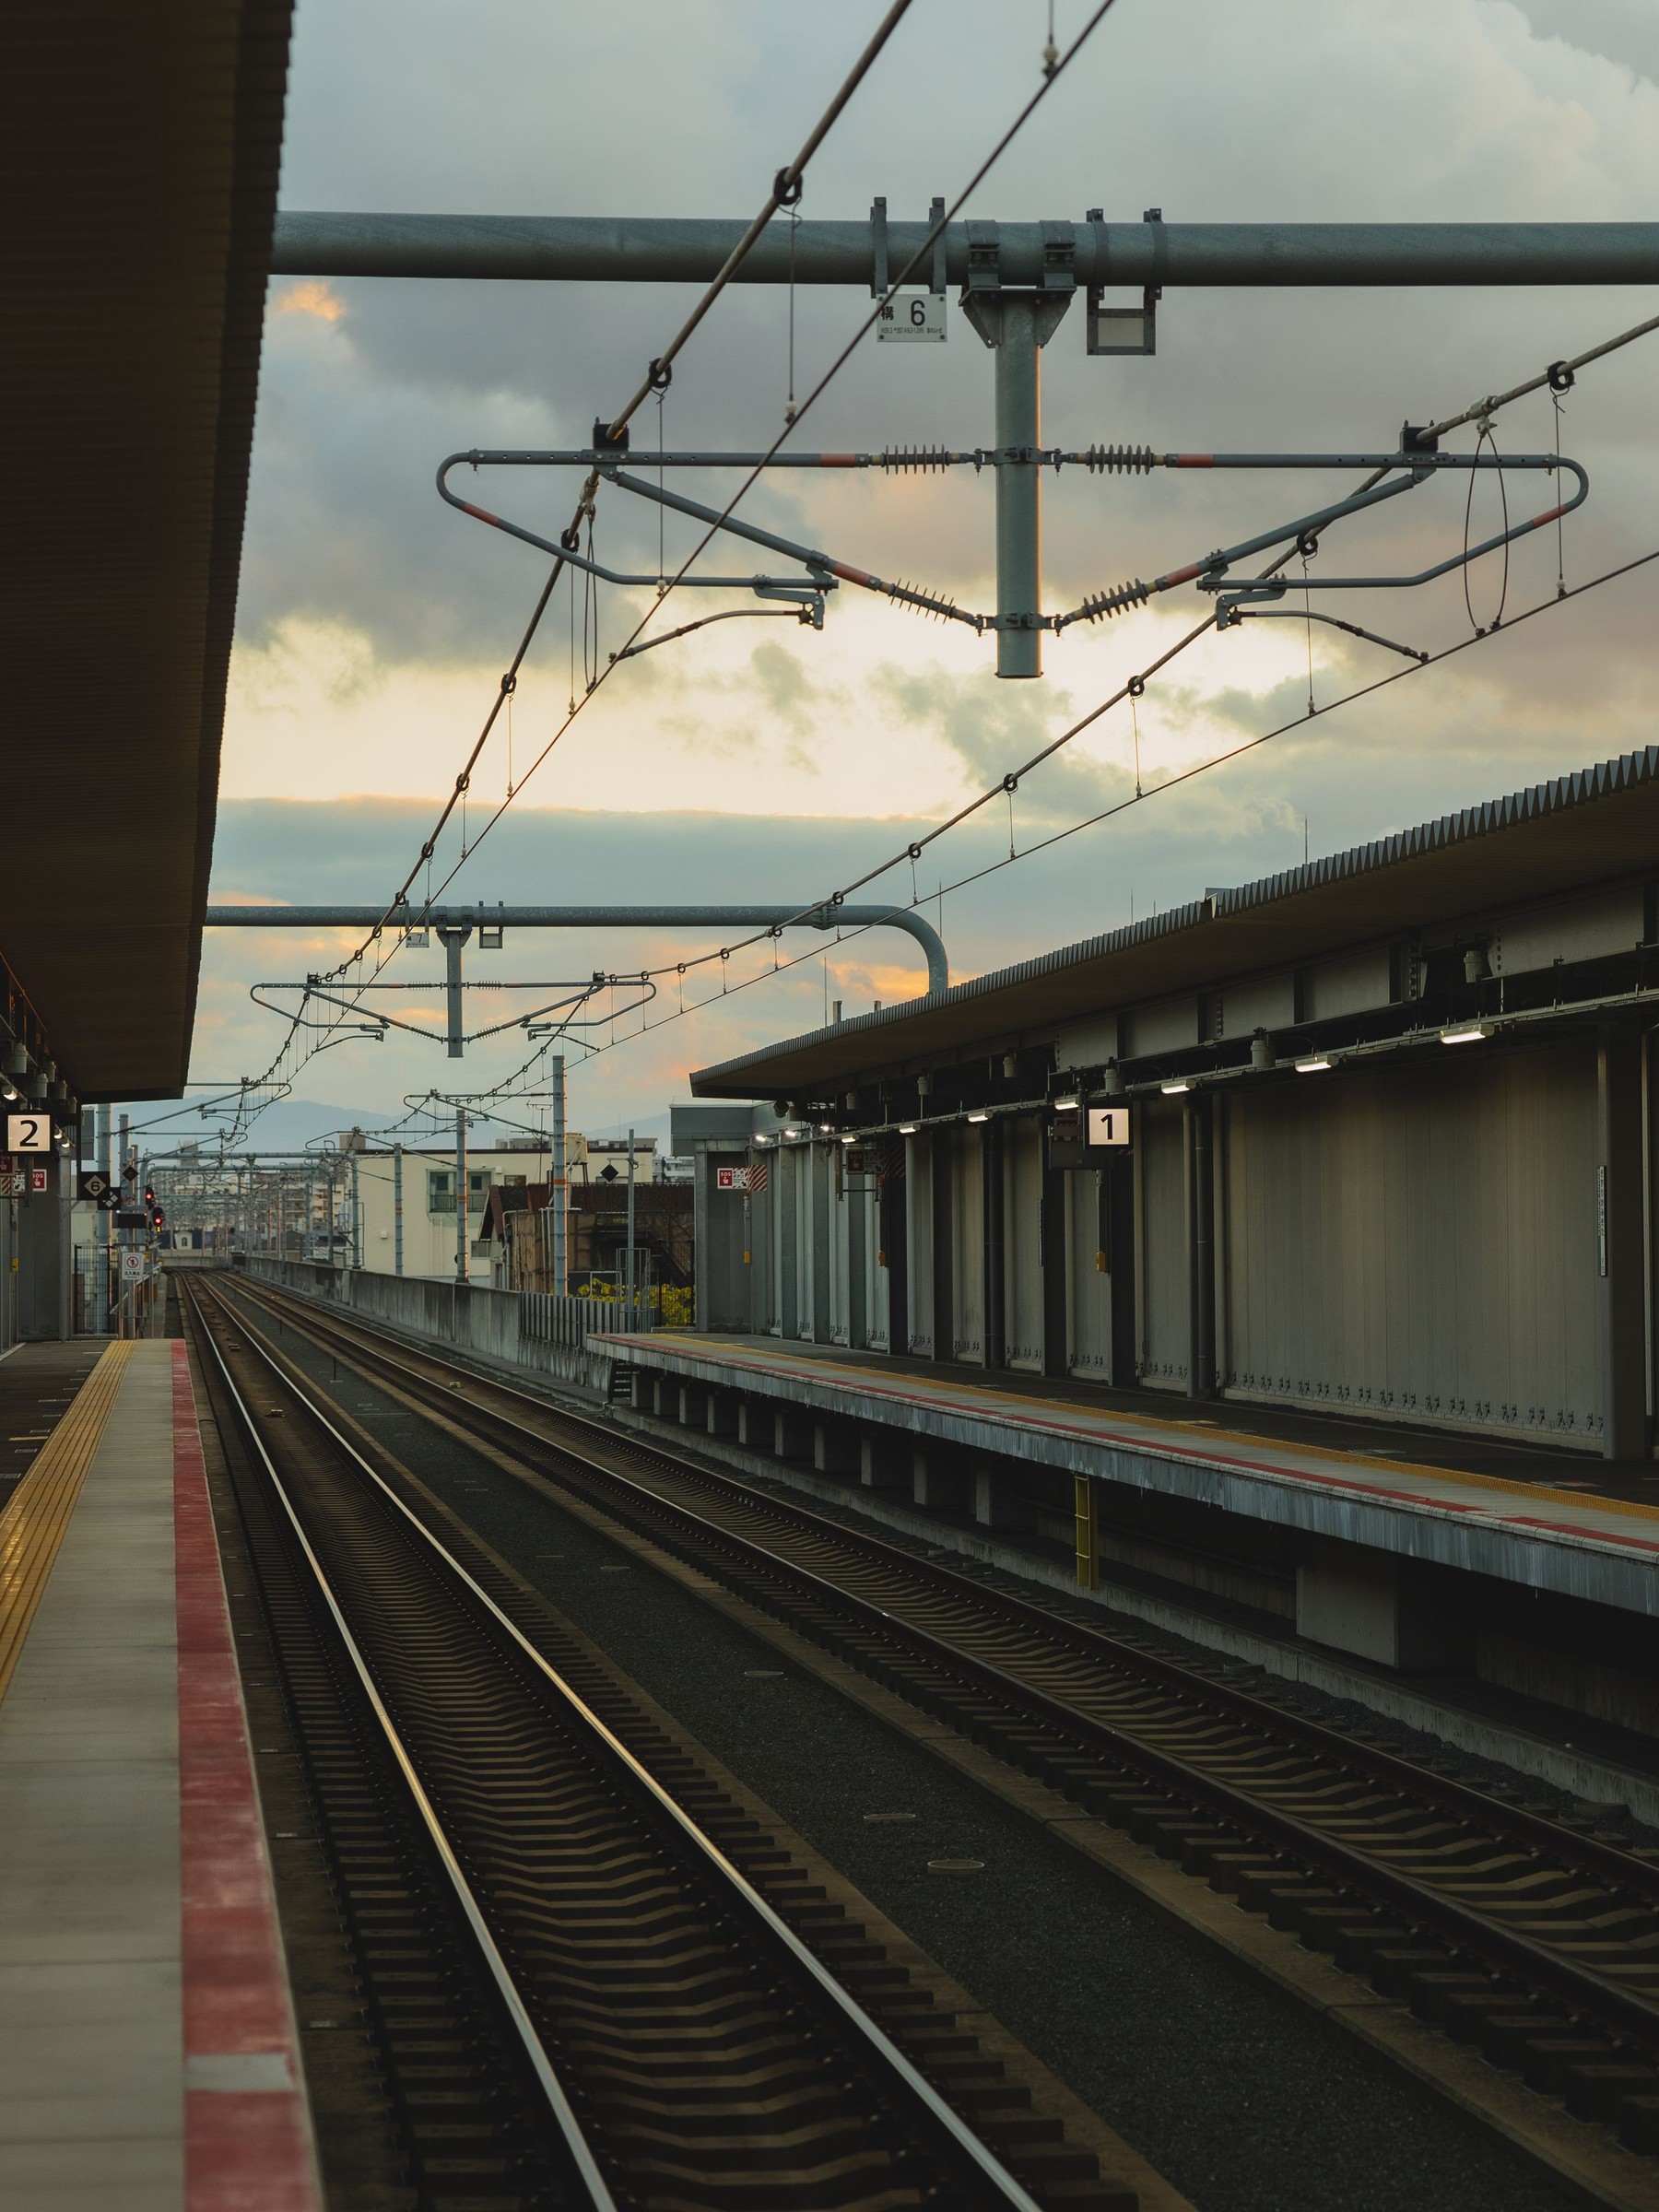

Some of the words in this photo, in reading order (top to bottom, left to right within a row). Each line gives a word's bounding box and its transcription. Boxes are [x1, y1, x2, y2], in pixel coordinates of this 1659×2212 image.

[911, 300, 925, 326] 6
[417, 934, 422, 943] 7
[19, 1120, 39, 1147] 2
[1100, 1113, 1113, 1140] 1
[90, 1181, 100, 1192] 6
